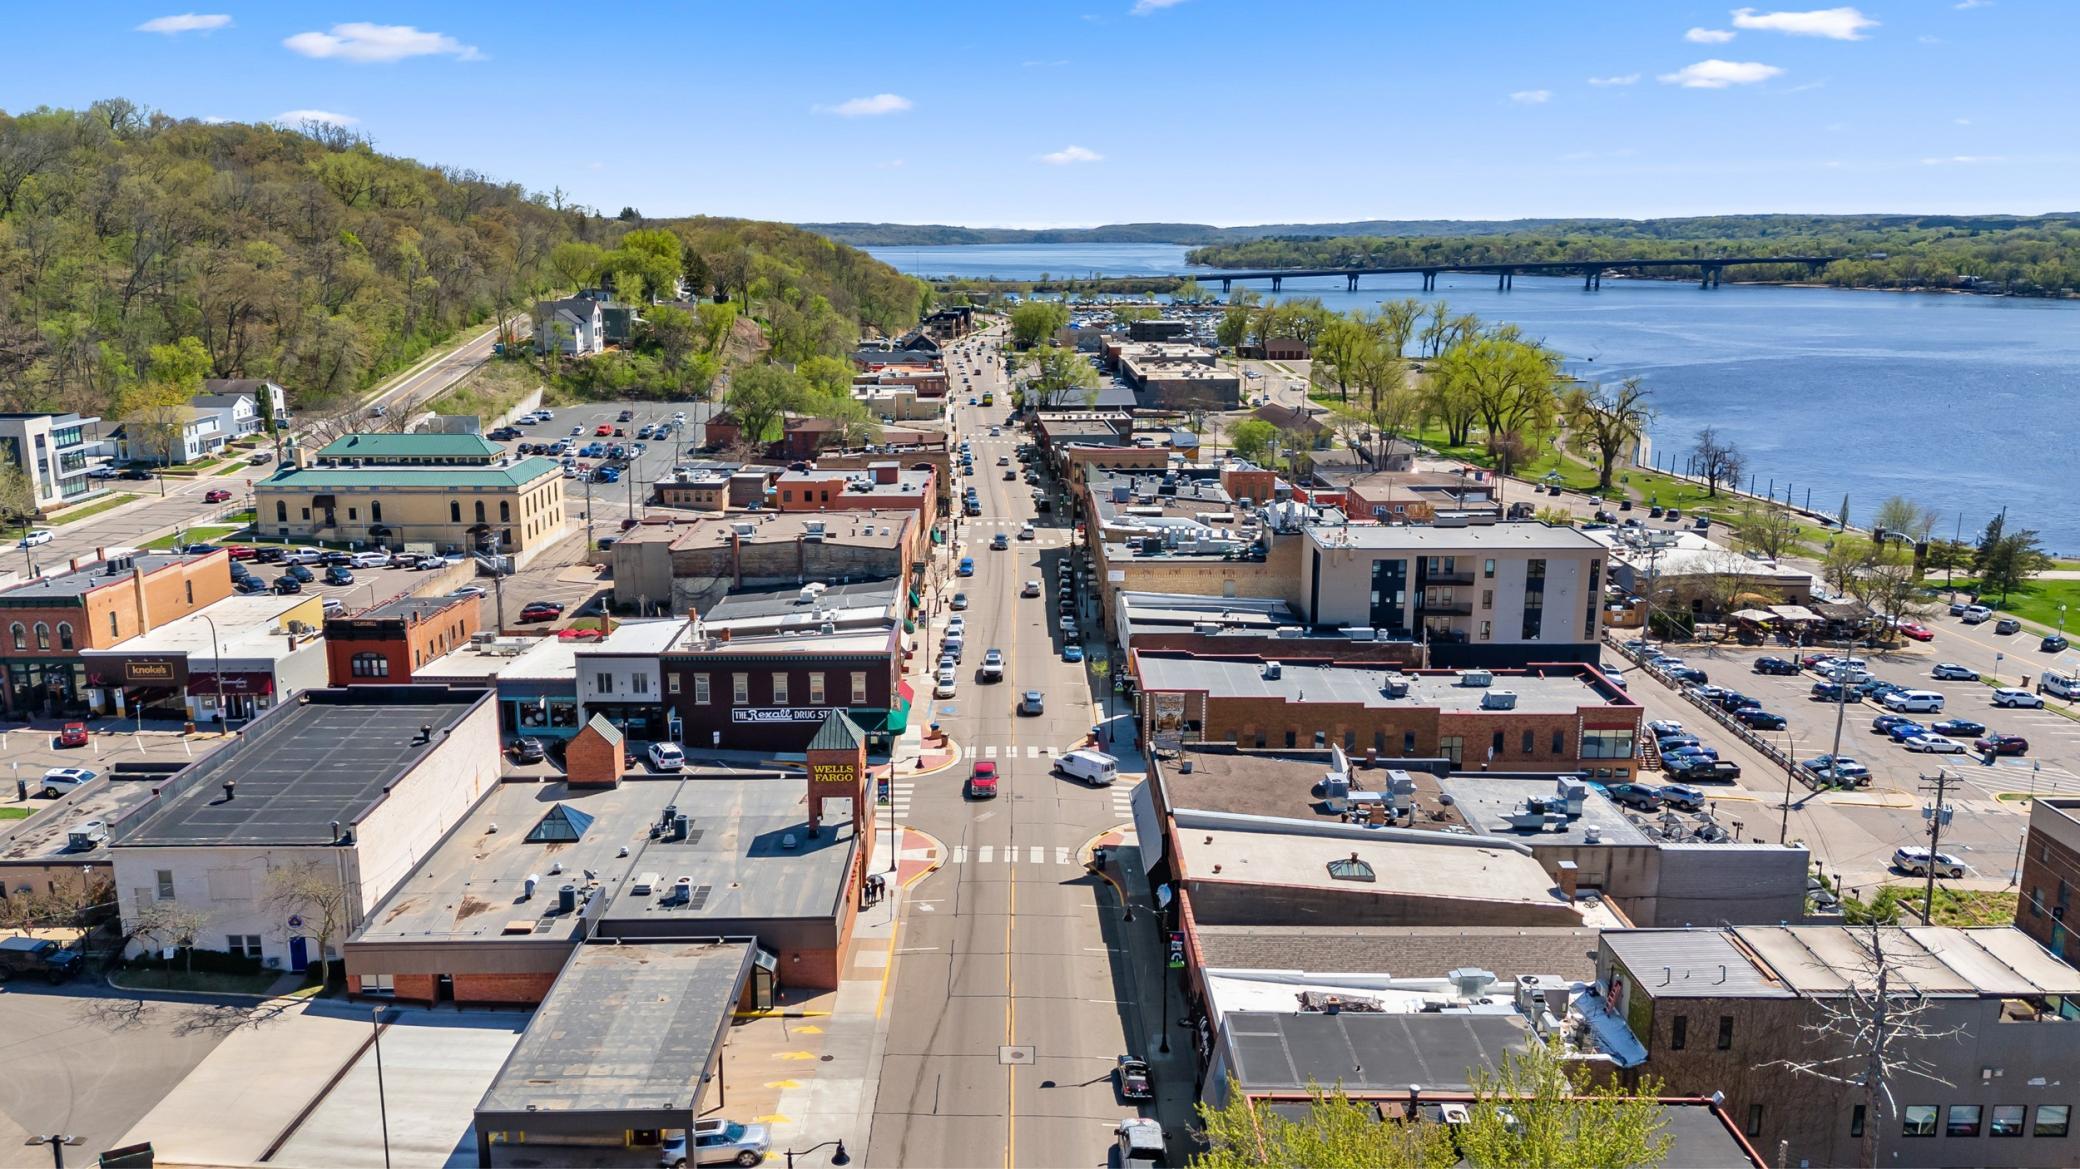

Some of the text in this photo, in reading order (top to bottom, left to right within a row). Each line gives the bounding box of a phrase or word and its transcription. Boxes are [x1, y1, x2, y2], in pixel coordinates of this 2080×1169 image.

[735, 711, 747, 720] THE
[747, 708, 792, 721] Rexall
[794, 710, 816, 720] DRUG
[814, 765, 854, 774] WELLS
[815, 773, 854, 782] FARGO
